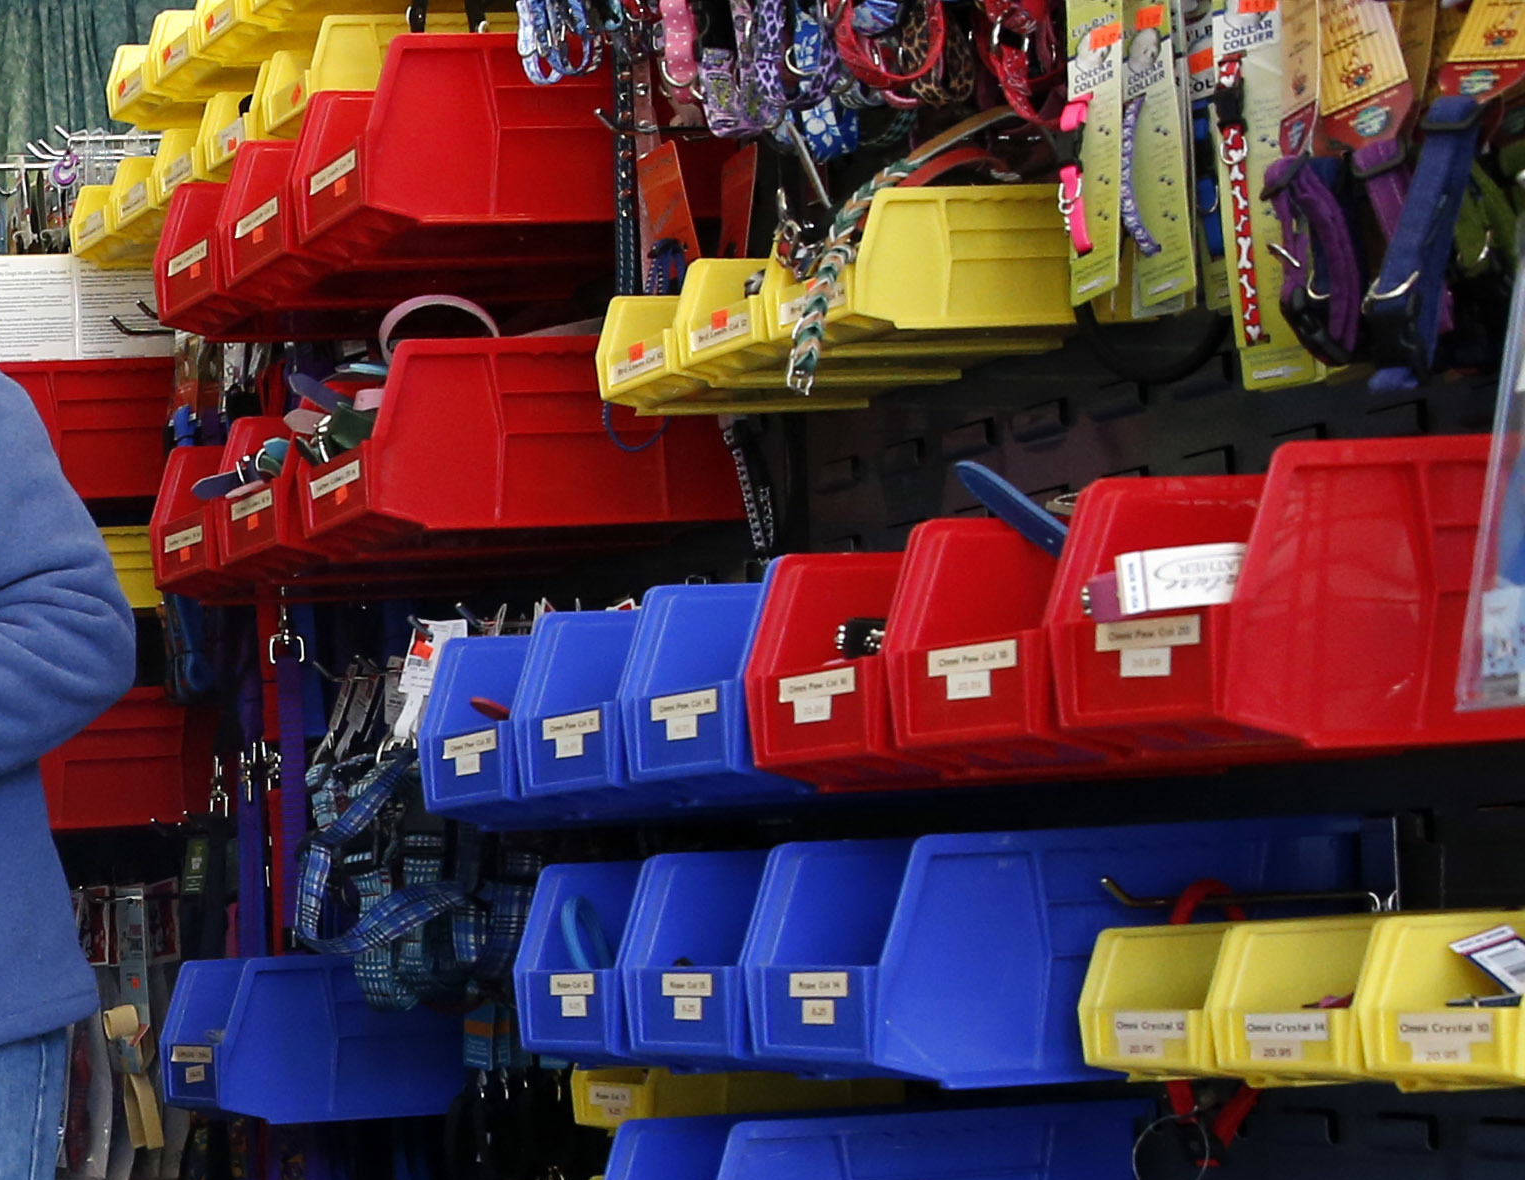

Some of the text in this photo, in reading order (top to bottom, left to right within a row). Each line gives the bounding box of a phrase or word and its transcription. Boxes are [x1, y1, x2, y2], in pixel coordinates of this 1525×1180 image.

[1224, 20, 1274, 40] COLLAR
[1223, 31, 1275, 51] COLLIER
[1074, 60, 1114, 85] COLLAR
[1127, 60, 1164, 85] COLLAR
[1074, 71, 1115, 96] COLLIER
[1127, 71, 1166, 97] COLLIER
[1116, 1020, 1138, 1030] Omni
[1142, 1021, 1173, 1031] Crystal
[1246, 1023, 1272, 1033] Omni
[1274, 1023, 1310, 1033] Crystal
[1399, 1024, 1428, 1033] Omni
[1431, 1023, 1473, 1034] Crystal
